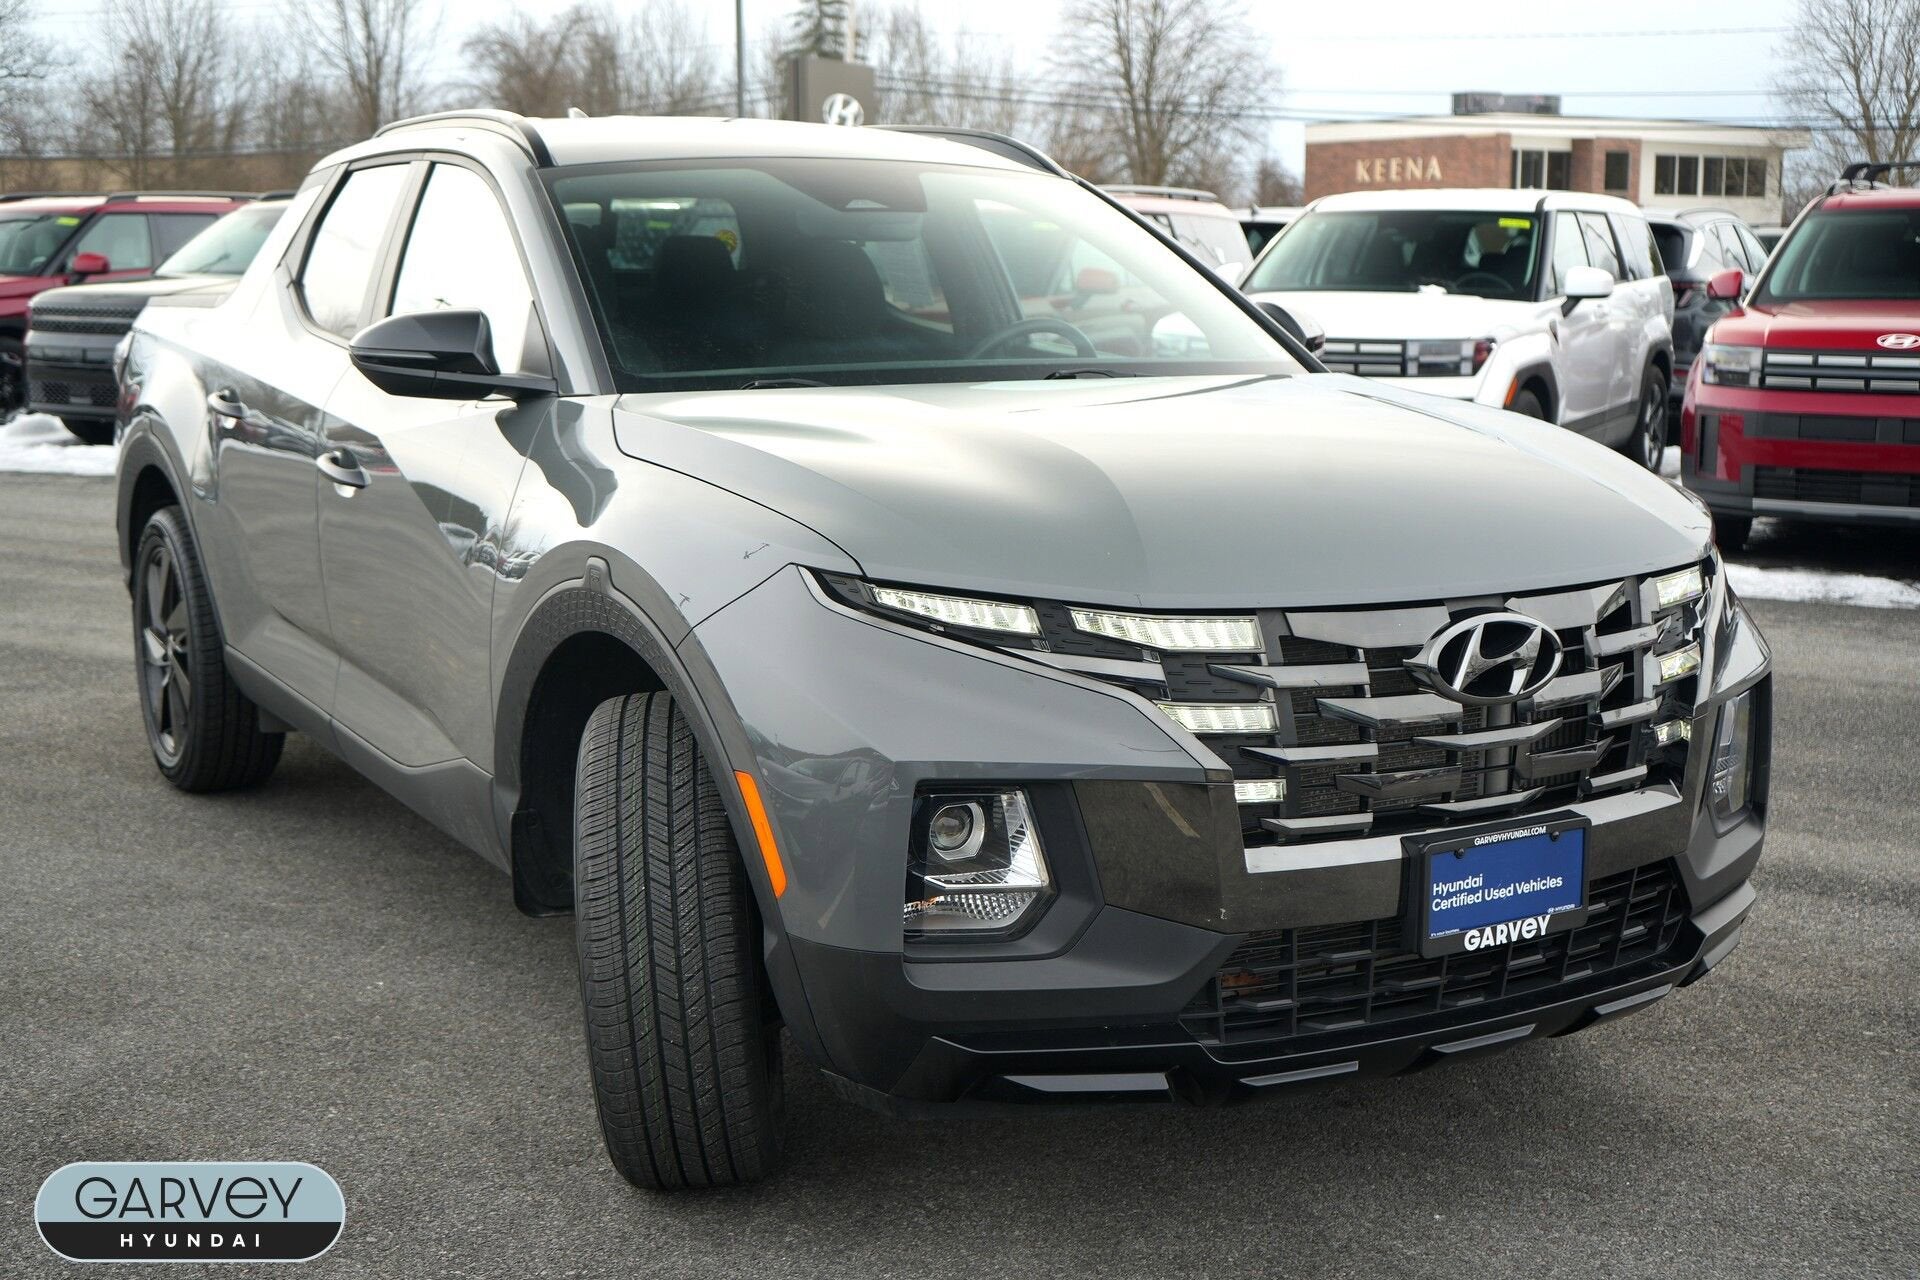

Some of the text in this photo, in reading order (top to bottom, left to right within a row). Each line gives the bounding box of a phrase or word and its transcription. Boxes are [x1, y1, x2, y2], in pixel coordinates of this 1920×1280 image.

[1356, 155, 1442, 182] KEENA
[1432, 876, 1563, 912] Certified Used Vehicles
[1433, 873, 1483, 896] Hyundai
